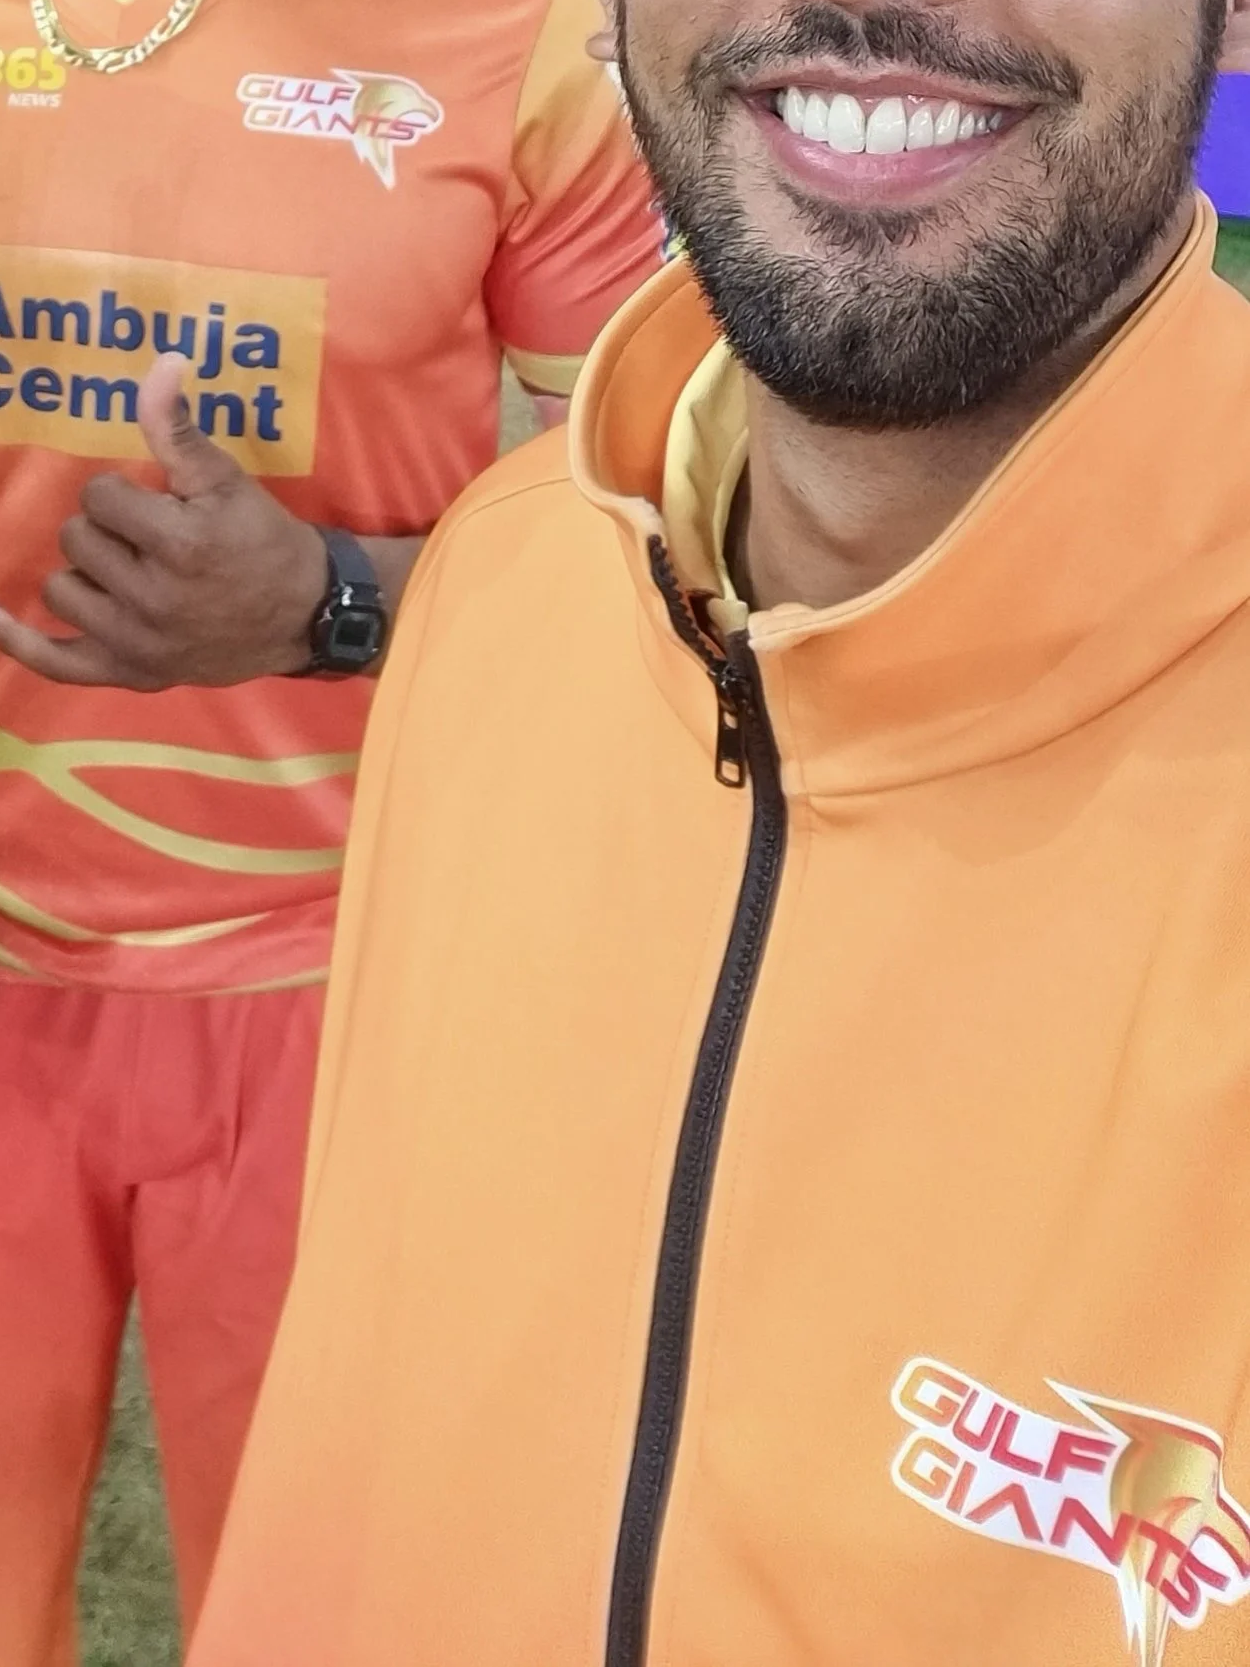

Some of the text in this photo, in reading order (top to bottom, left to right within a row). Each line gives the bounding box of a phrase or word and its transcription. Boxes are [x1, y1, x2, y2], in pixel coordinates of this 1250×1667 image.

[7, 92, 62, 108] NEWS
[241, 78, 357, 106] GULF
[247, 105, 427, 141] GIANTS
[899, 1364, 1117, 1483] GULF
[898, 1434, 1232, 1618] GIANTS
